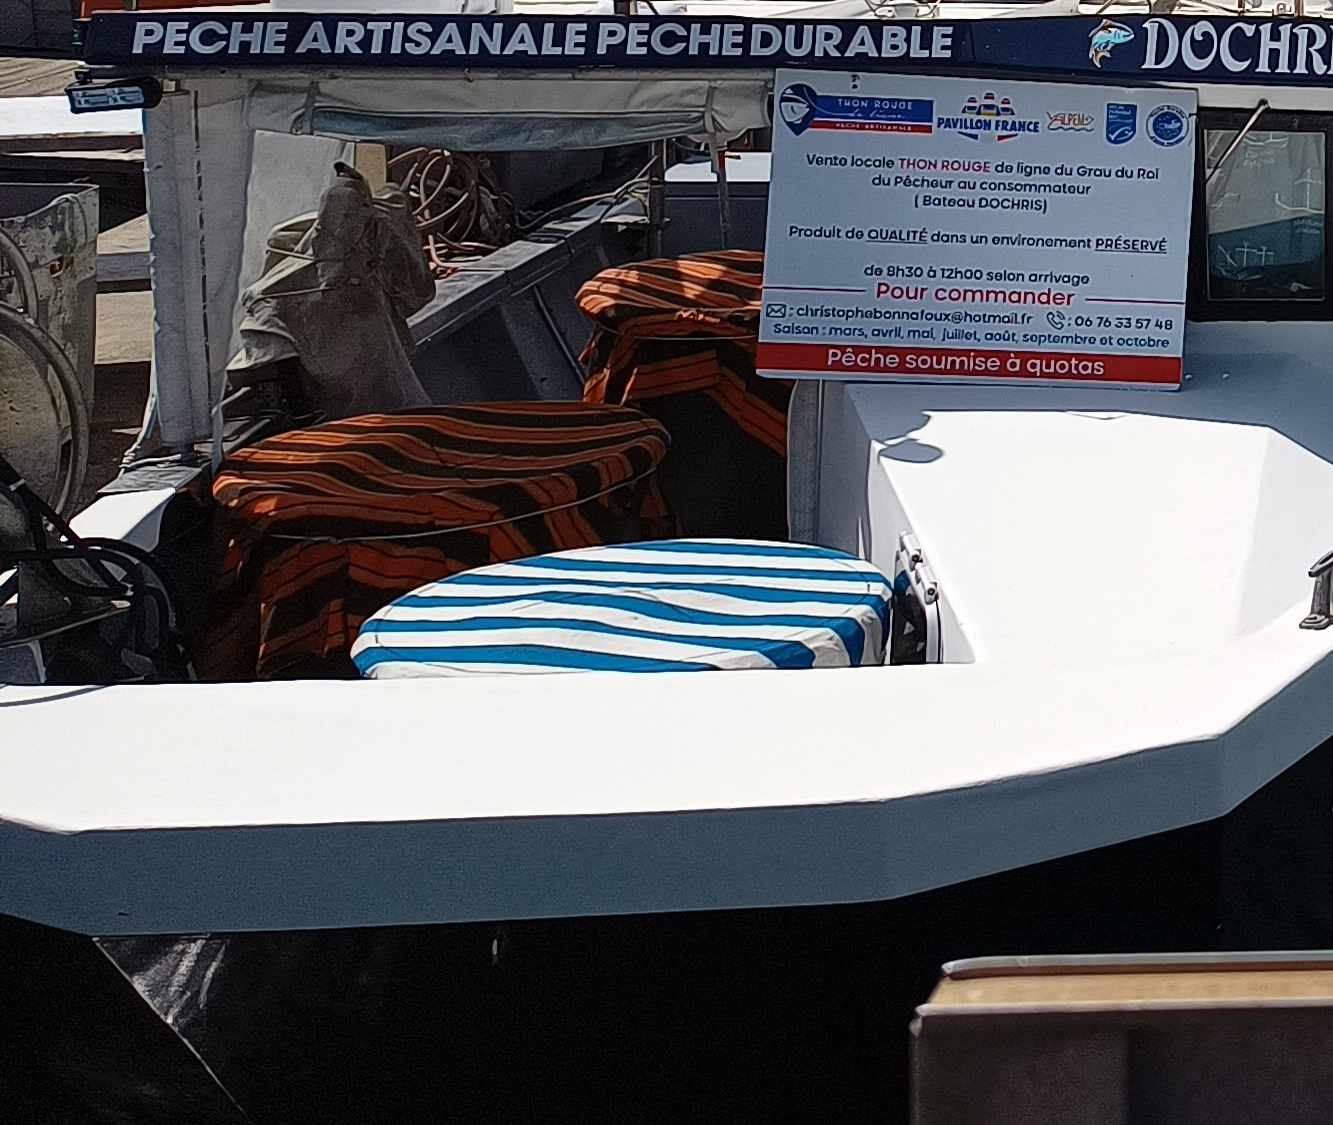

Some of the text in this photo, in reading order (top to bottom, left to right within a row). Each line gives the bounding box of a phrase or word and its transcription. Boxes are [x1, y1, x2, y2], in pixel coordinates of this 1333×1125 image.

[131, 21, 954, 59] PECHE ARTISANALE PECHE DURABLE
[837, 98, 914, 111] THON ROUGE
[936, 117, 1040, 133] PAVILLON FRANCE
[806, 153, 1160, 180] Vente locale THON ROUGE de ligne du Grau du Roi
[871, 174, 1092, 196] du Pêcheur au consommateur
[922, 195, 976, 208] Bateau
[978, 196, 1048, 214] DOCHRIS)
[789, 225, 1167, 251] Produit de QUALITÉ dans un environement PRÉSERVÉ
[864, 264, 1090, 287] de 8h30 à 12h00 selon arrivage
[876, 282, 1076, 306] Pour commander
[1074, 315, 1093, 328] 06
[1096, 316, 1112, 329] 76
[1135, 318, 1152, 330] 57
[1154, 318, 1173, 331] 48
[773, 322, 819, 335] Saison
[828, 326, 868, 339] mars,
[871, 325, 904, 339] avril,
[907, 327, 936, 341] mai,
[941, 328, 981, 343] juillet,
[984, 330, 1019, 344] août,
[1022, 332, 1097, 346] septembre
[1100, 334, 1114, 346] et
[1116, 335, 1170, 348] octobre
[827, 347, 1105, 376] Pêche soumise à quotas
